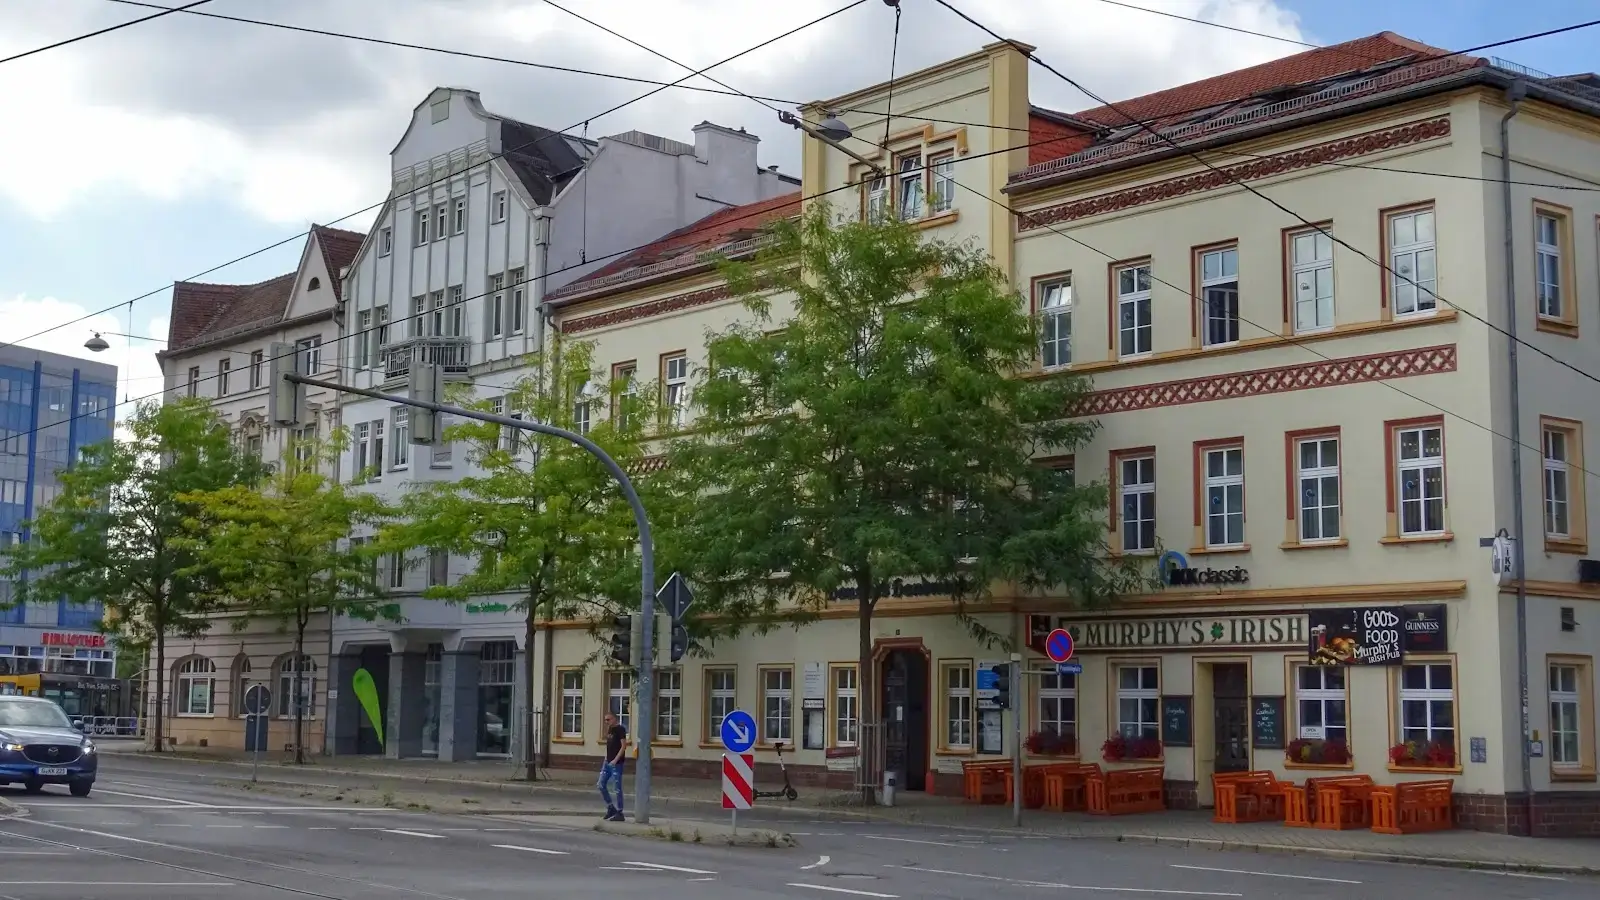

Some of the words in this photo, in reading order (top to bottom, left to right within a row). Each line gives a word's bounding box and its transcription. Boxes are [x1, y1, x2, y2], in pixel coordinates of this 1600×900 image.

[1199, 565, 1249, 585] classic
[1363, 609, 1400, 629] GOOD
[1405, 620, 1440, 631] GUINNESS
[41, 632, 106, 648] BIBLIOTHEK
[1084, 619, 1205, 647] MURPHY'S
[1229, 616, 1304, 645] IRISH
[1365, 629, 1399, 644] FOOD
[1353, 641, 1400, 659] Murphys
[1368, 654, 1386, 664] IRISH
[1386, 651, 1401, 661] PUB
